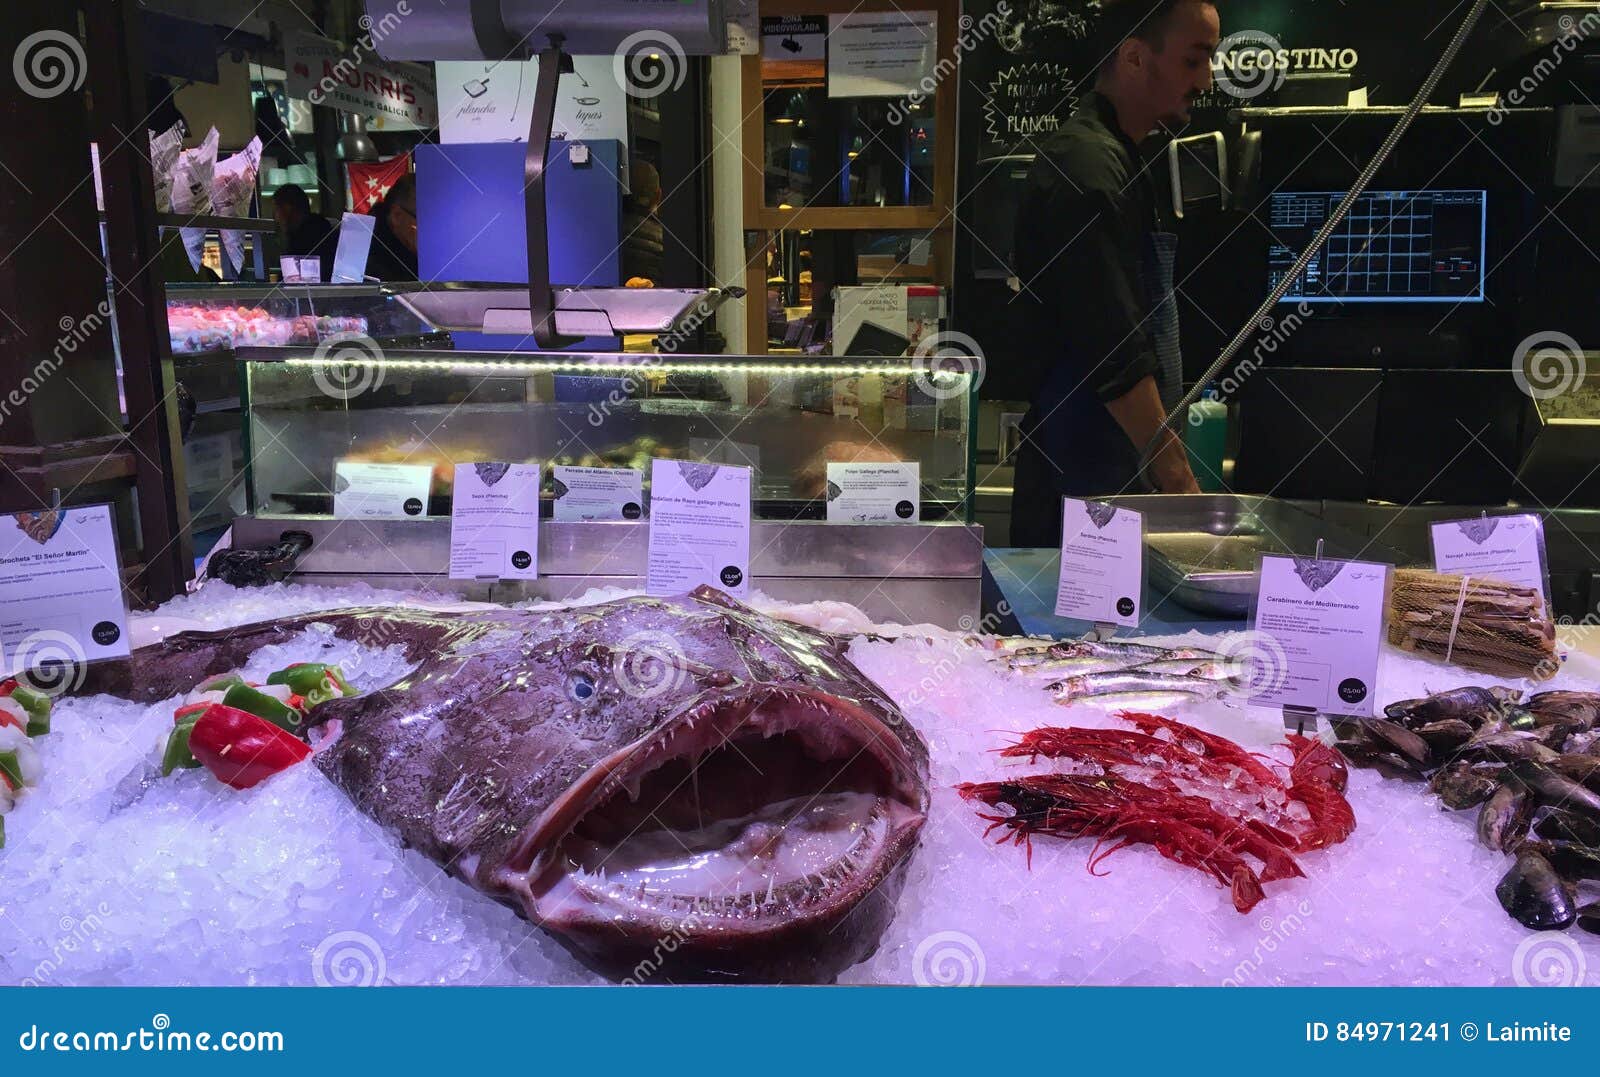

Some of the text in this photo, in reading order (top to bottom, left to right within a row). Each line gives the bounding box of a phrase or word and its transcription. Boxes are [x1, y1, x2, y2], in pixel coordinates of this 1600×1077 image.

[781, 15, 802, 23] ZONA
[377, 102, 409, 118] GALICIA
[456, 103, 497, 118] plancha
[575, 108, 603, 124] tapas
[1007, 114, 1060, 133] PLANCHA
[1266, 596, 1302, 605] Carabinero
